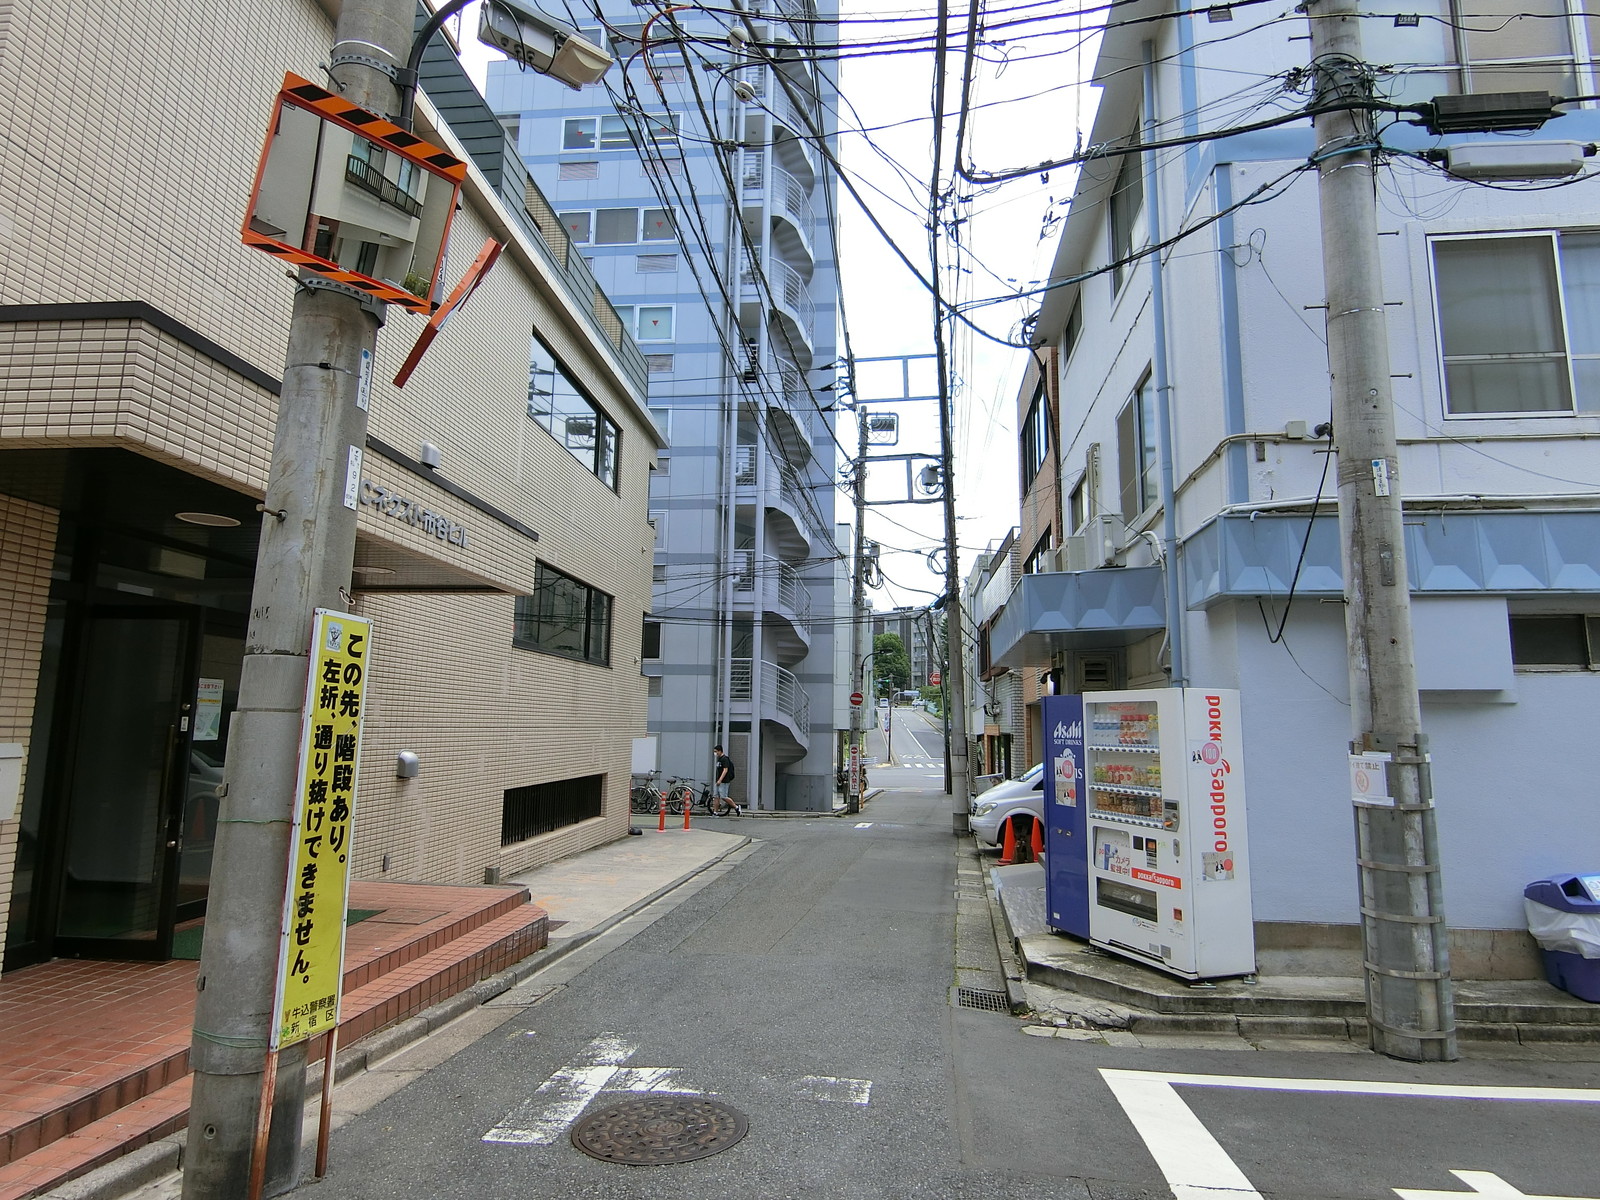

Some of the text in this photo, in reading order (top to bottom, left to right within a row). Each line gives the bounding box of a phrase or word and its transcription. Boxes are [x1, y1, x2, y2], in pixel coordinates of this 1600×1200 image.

[1053, 720, 1082, 739] Asahi
[329, 633, 363, 865] この先、階段あり。
[291, 658, 342, 984] 左折、通り抜けできません。
[1115, 855, 1131, 867] カメラ
[292, 994, 335, 1019] 牛込警察署
[291, 1008, 334, 1034] 新宿区
